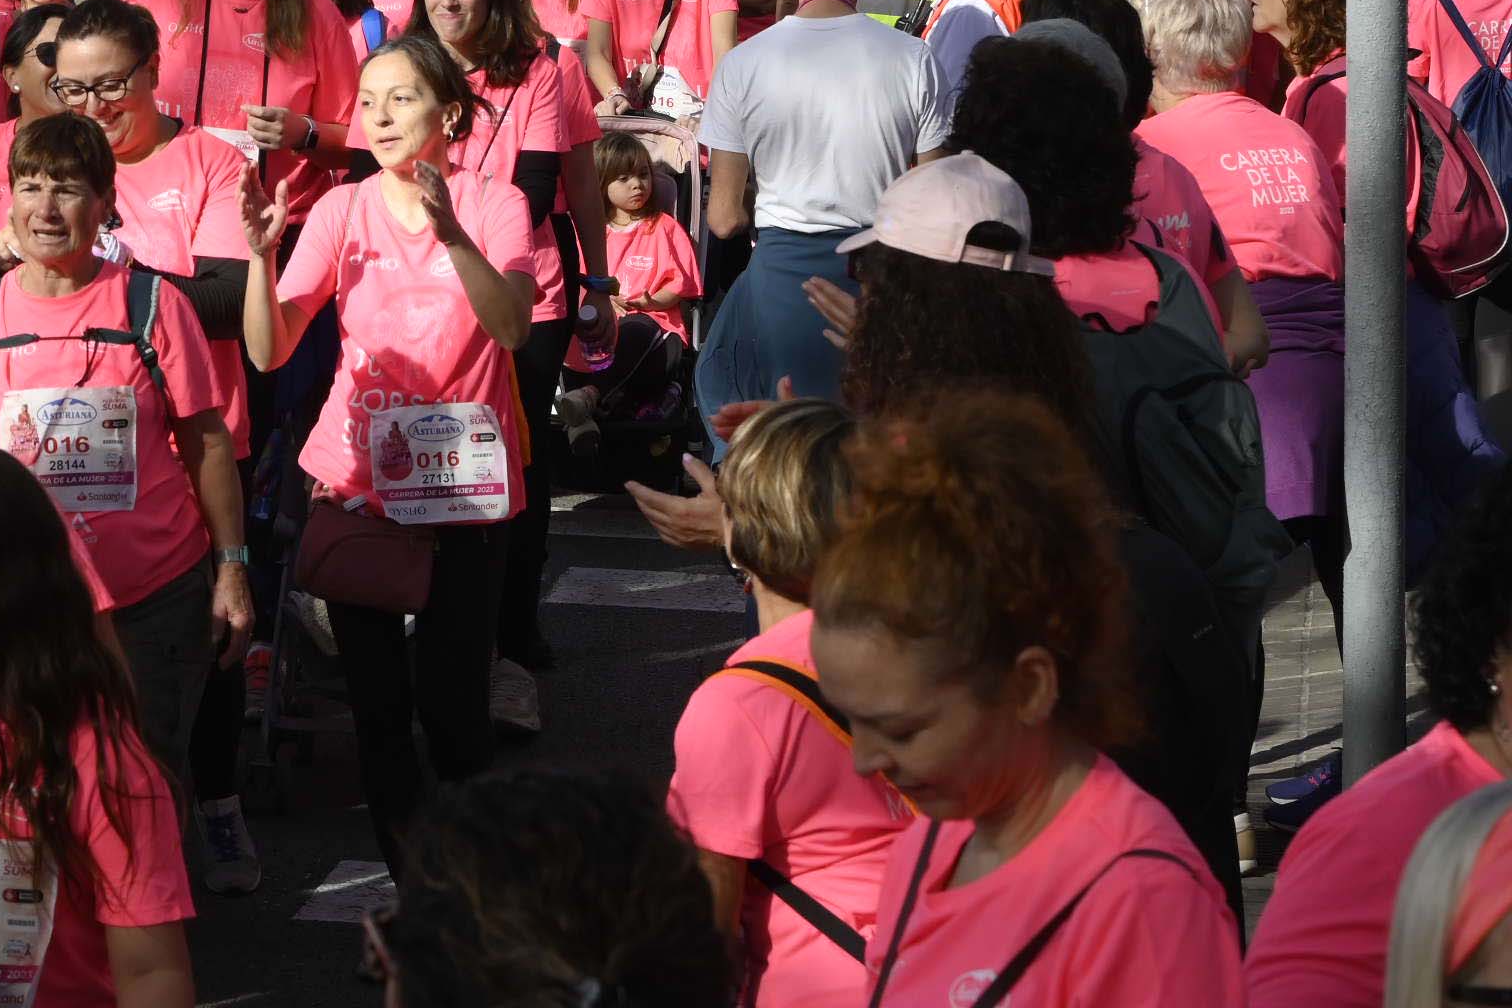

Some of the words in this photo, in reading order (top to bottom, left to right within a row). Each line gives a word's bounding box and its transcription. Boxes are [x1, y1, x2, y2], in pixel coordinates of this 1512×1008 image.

[1481, 36, 1500, 50] DE
[1220, 147, 1308, 171] CARRERA
[1246, 168, 1274, 186] DE
[1275, 167, 1301, 184] LA
[1251, 185, 1311, 208] MUJER
[413, 425, 460, 436] ASTURIANA
[43, 436, 90, 455] 016
[49, 460, 86, 471] 28144
[416, 450, 461, 469] 016
[422, 473, 455, 484] 27131
[389, 489, 424, 498] CARRERA
[449, 487, 475, 495] MUJER
[458, 502, 498, 512] Santander
